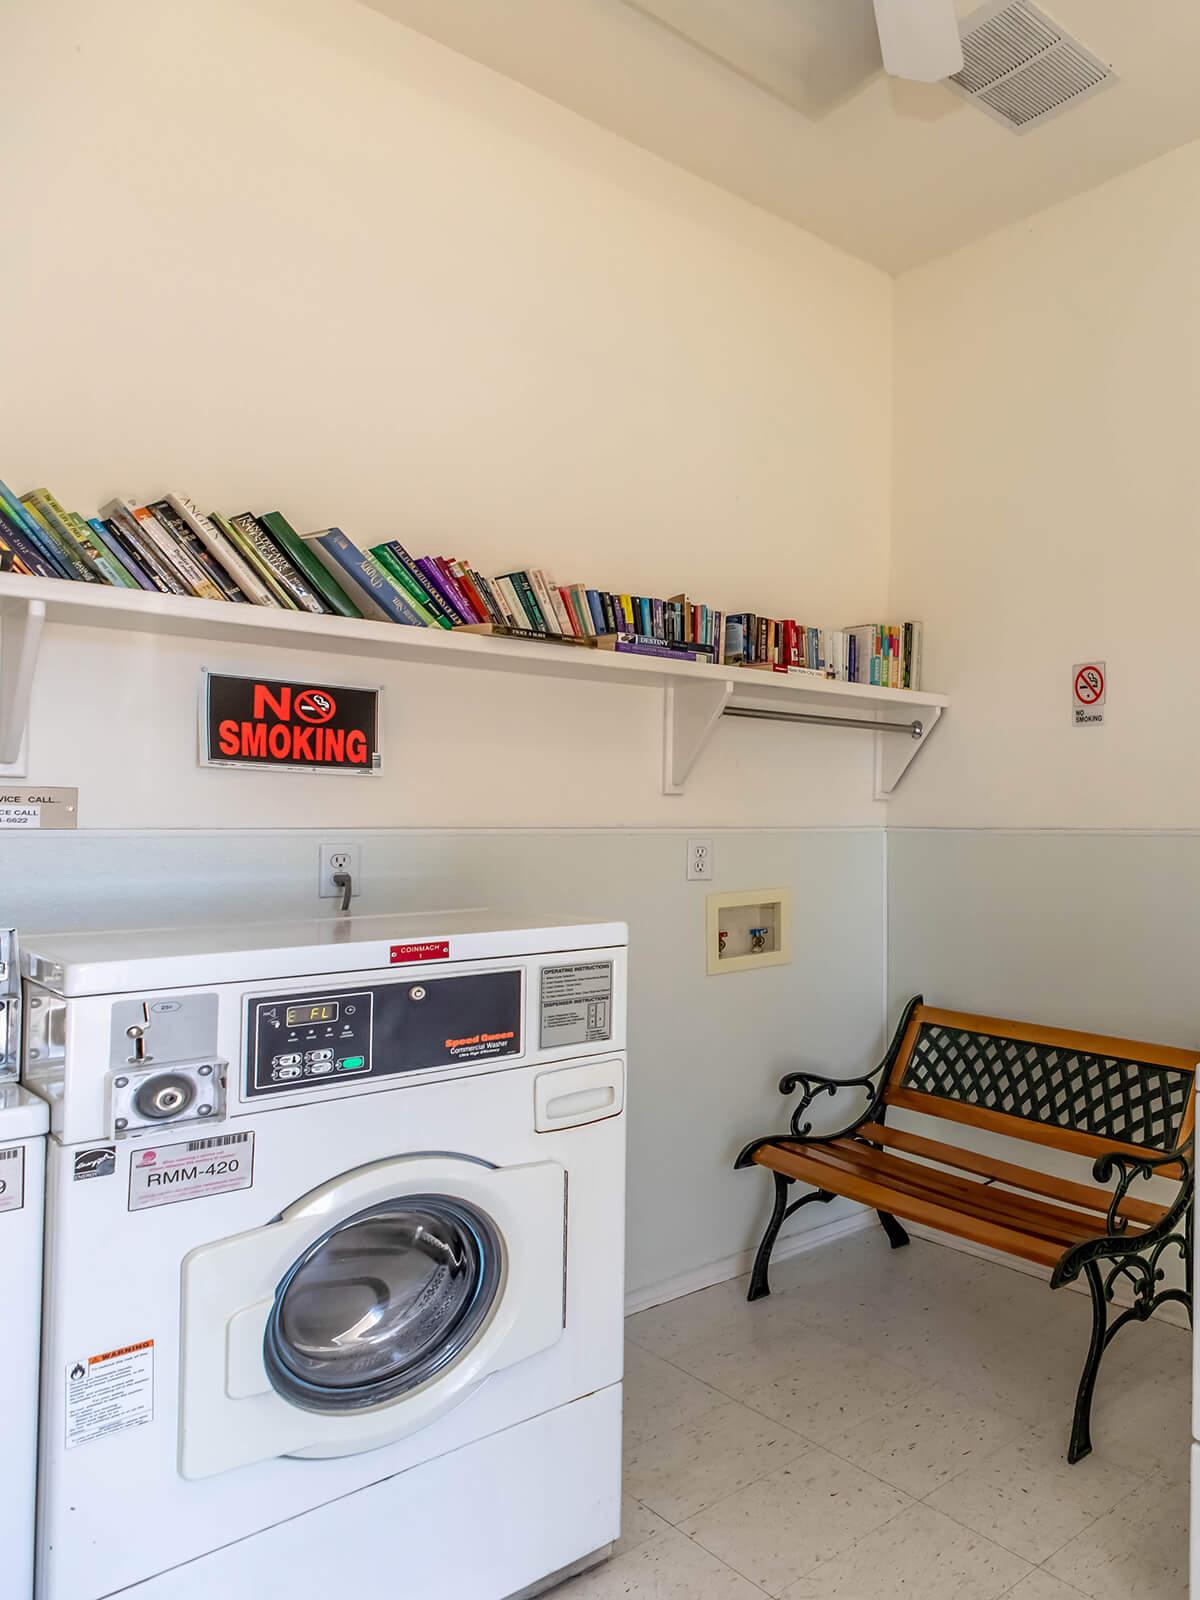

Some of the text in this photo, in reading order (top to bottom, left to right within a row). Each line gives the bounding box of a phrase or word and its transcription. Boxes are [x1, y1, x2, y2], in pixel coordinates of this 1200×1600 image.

[13, 536, 29, 554] 2012
[640, 636, 668, 646] DESTINY
[1076, 715, 1102, 723] SMOKING
[218, 720, 368, 764] SMOKING
[400, 944, 440, 953] COINMACH
[574, 964, 609, 972] INSTRUCTIONS
[573, 996, 608, 1004] INSTRUCTIONS
[445, 1031, 514, 1047] Speed Queen
[450, 1040, 508, 1054] Commercial Washer
[147, 1159, 239, 1188] RMM-420
[102, 1342, 149, 1359] WARNING
